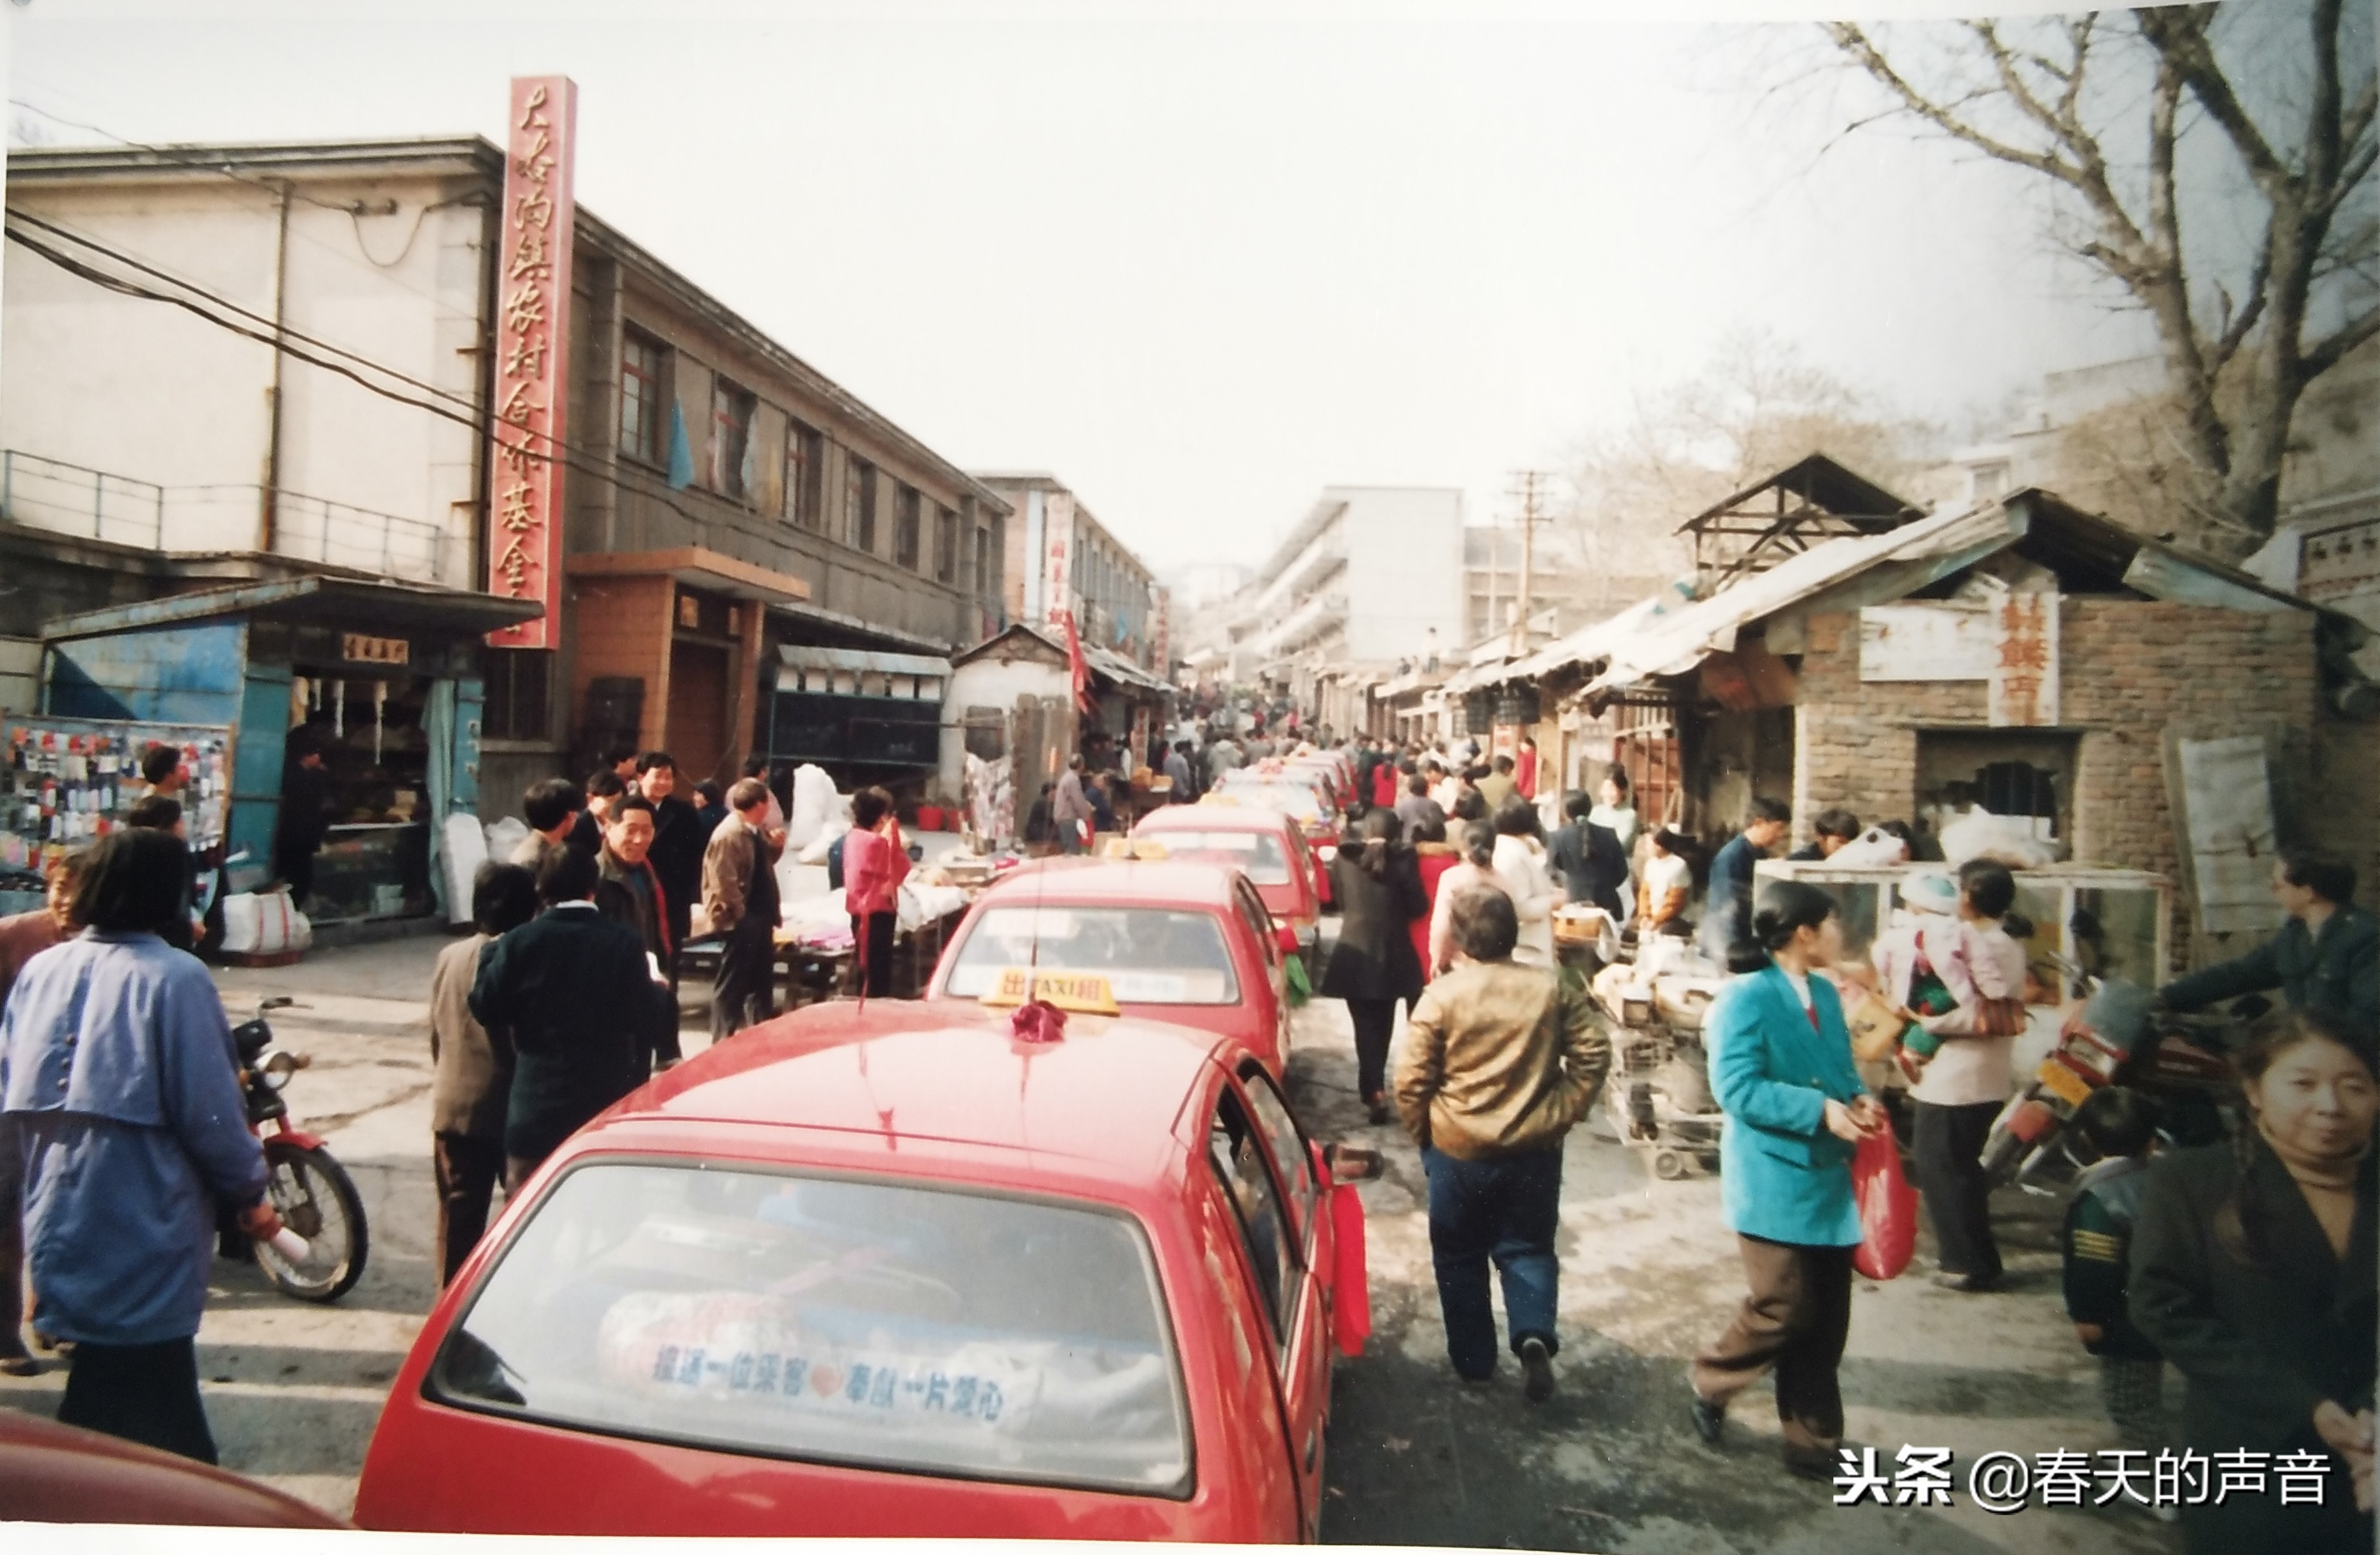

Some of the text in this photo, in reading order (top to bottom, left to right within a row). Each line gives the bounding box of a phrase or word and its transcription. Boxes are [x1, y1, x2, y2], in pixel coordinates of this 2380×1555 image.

[496, 84, 558, 634] 大峪沟镇农村合作基金
